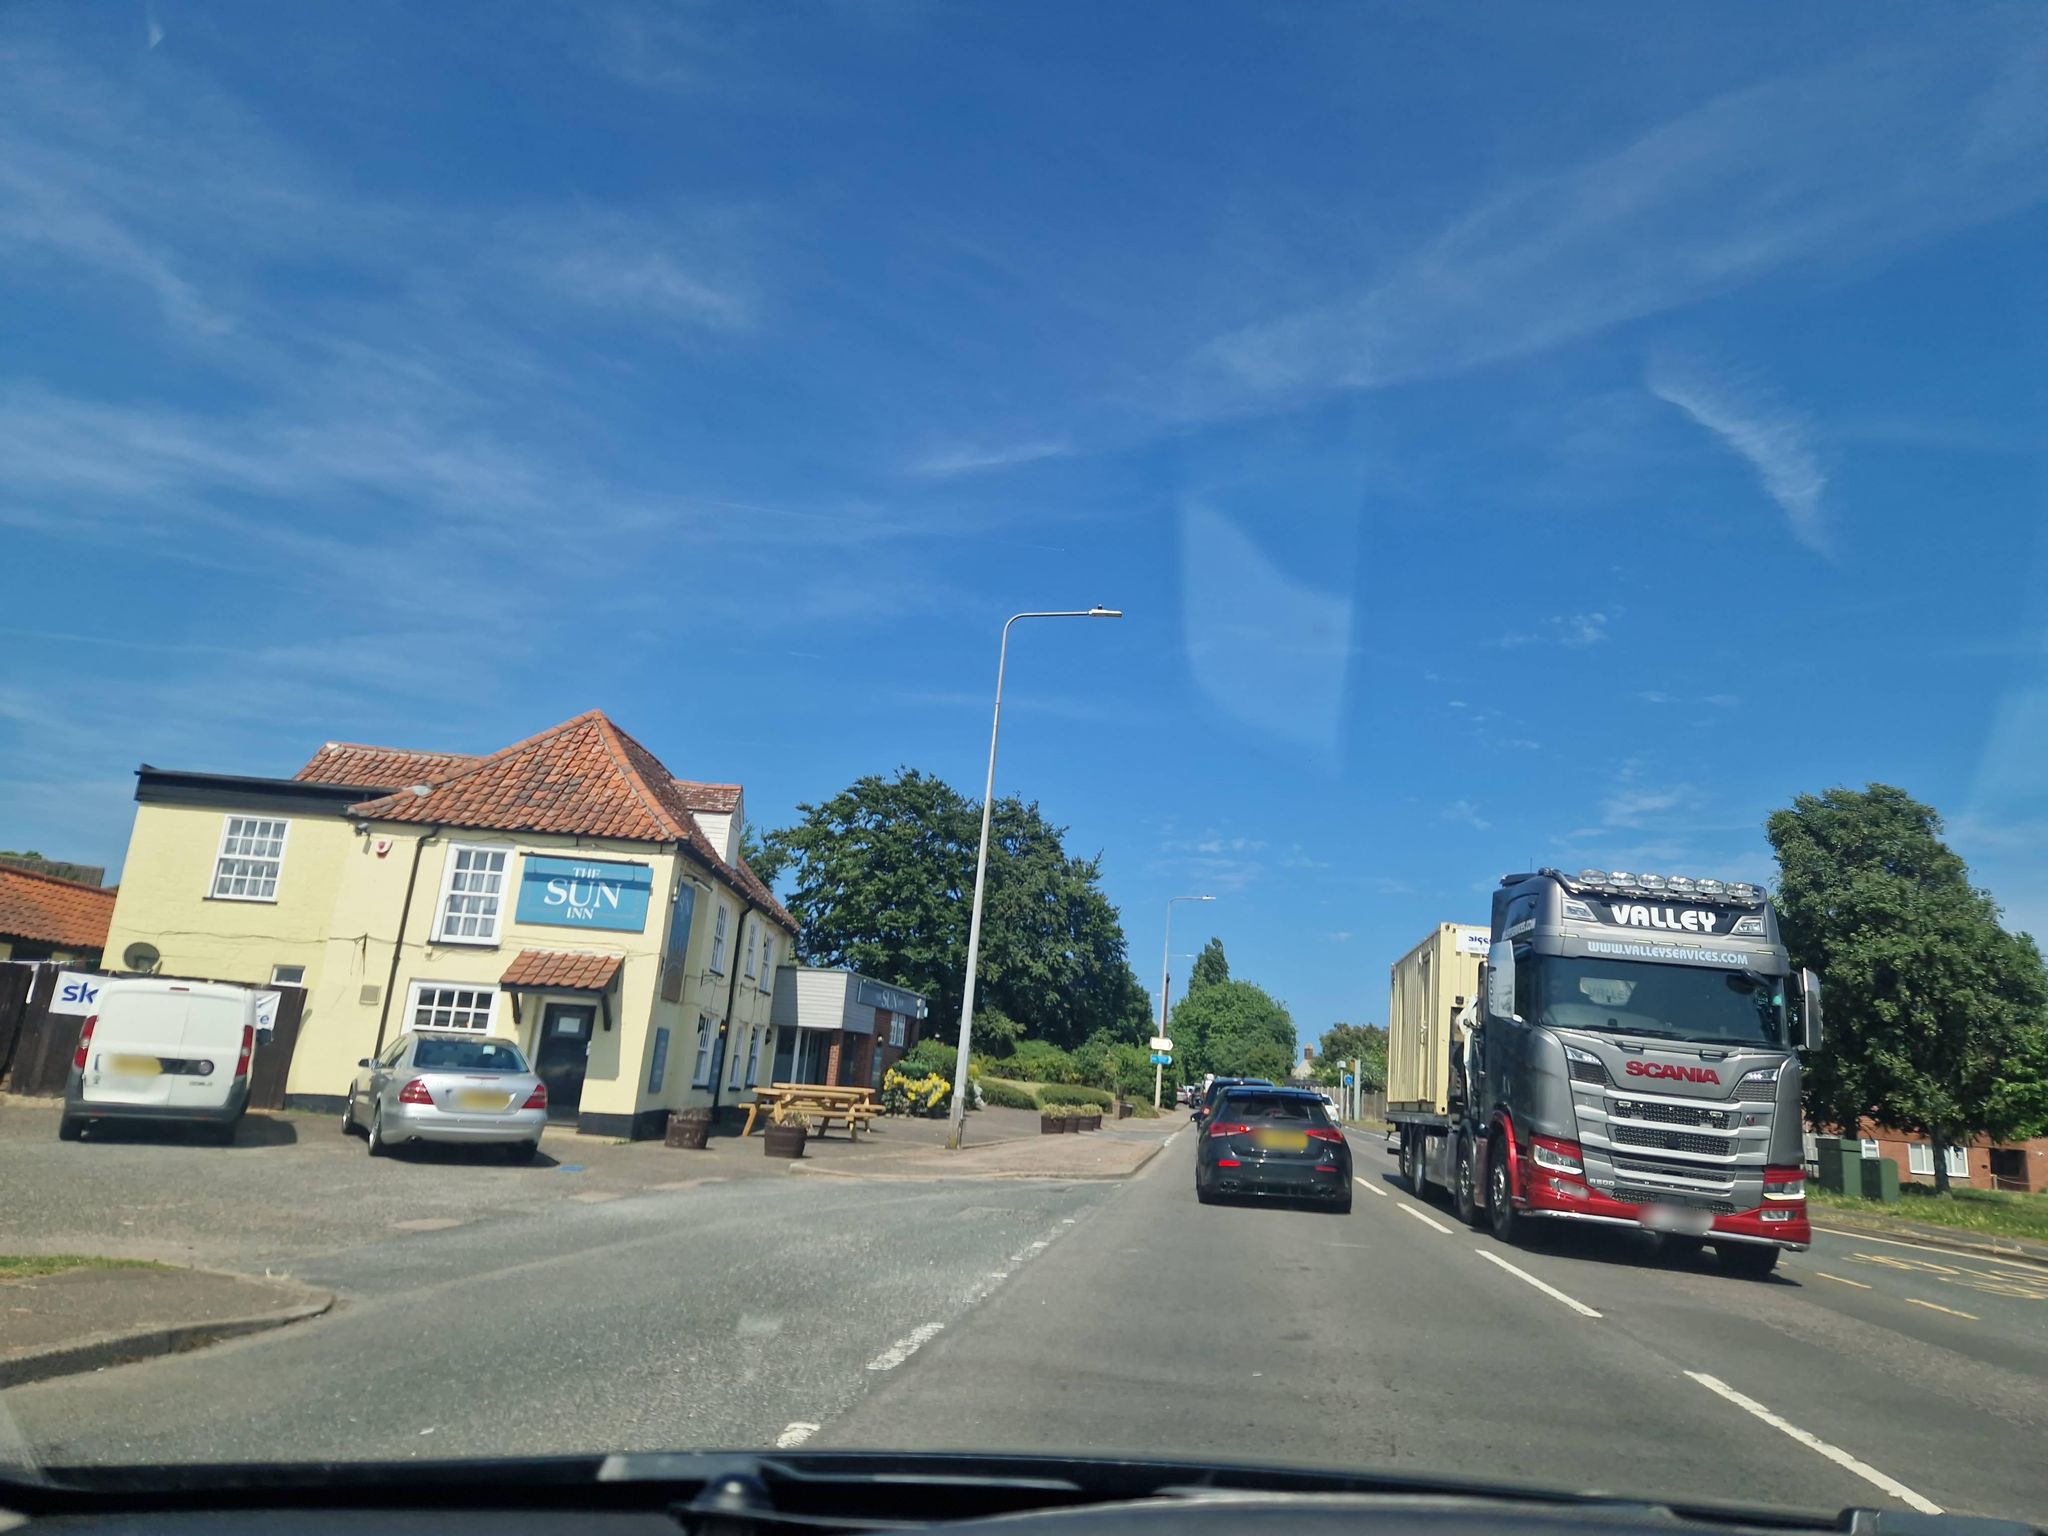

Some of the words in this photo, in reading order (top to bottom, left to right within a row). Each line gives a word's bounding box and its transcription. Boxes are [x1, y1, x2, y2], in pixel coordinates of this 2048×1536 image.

[573, 867, 600, 879] THE
[544, 878, 622, 909] SUN
[566, 907, 595, 920] INN
[1610, 904, 1716, 932] VALLEY
[1587, 941, 1748, 965] WWW.VALLEYSERVICES.COM
[1626, 1061, 1720, 1085] SCANIA
